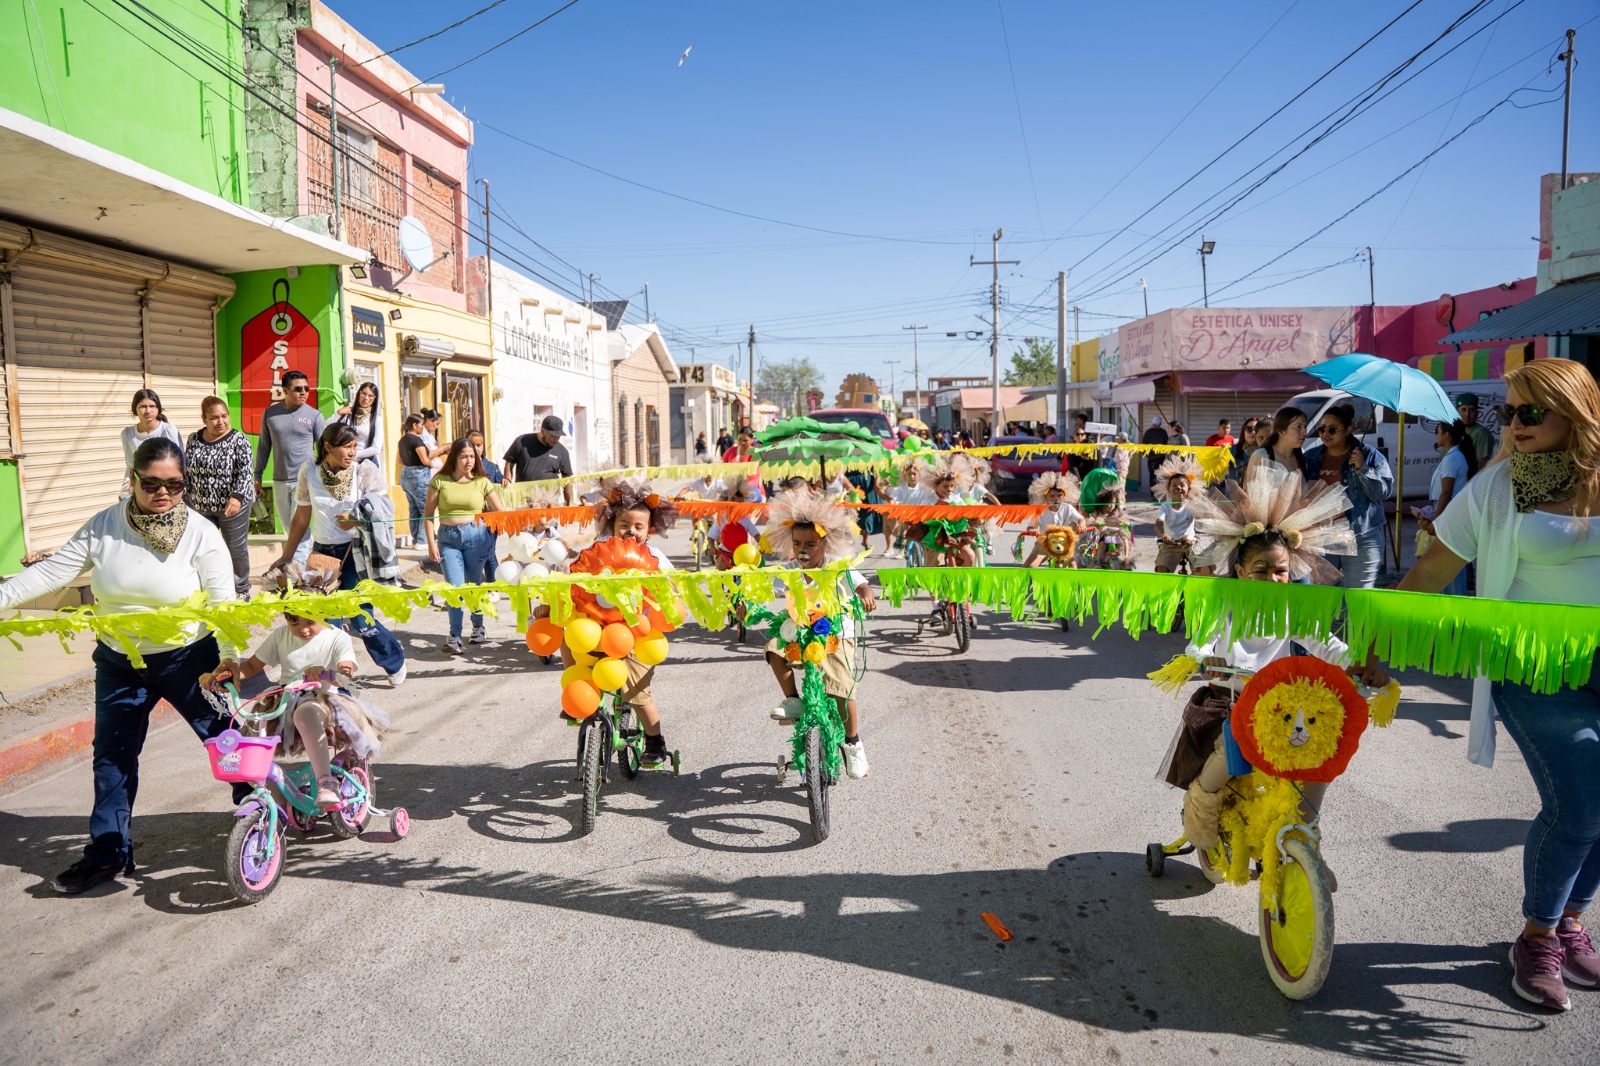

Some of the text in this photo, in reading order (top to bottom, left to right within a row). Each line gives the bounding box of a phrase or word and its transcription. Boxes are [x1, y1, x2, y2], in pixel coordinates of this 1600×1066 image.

[1192, 313, 1304, 329] ESTETICA UNISEX
[503, 310, 571, 367] Confecciones
[270, 340, 289, 406] SALD
[691, 365, 704, 383] 43
[1394, 456, 1411, 466] Slo
[1412, 457, 1422, 466] en
